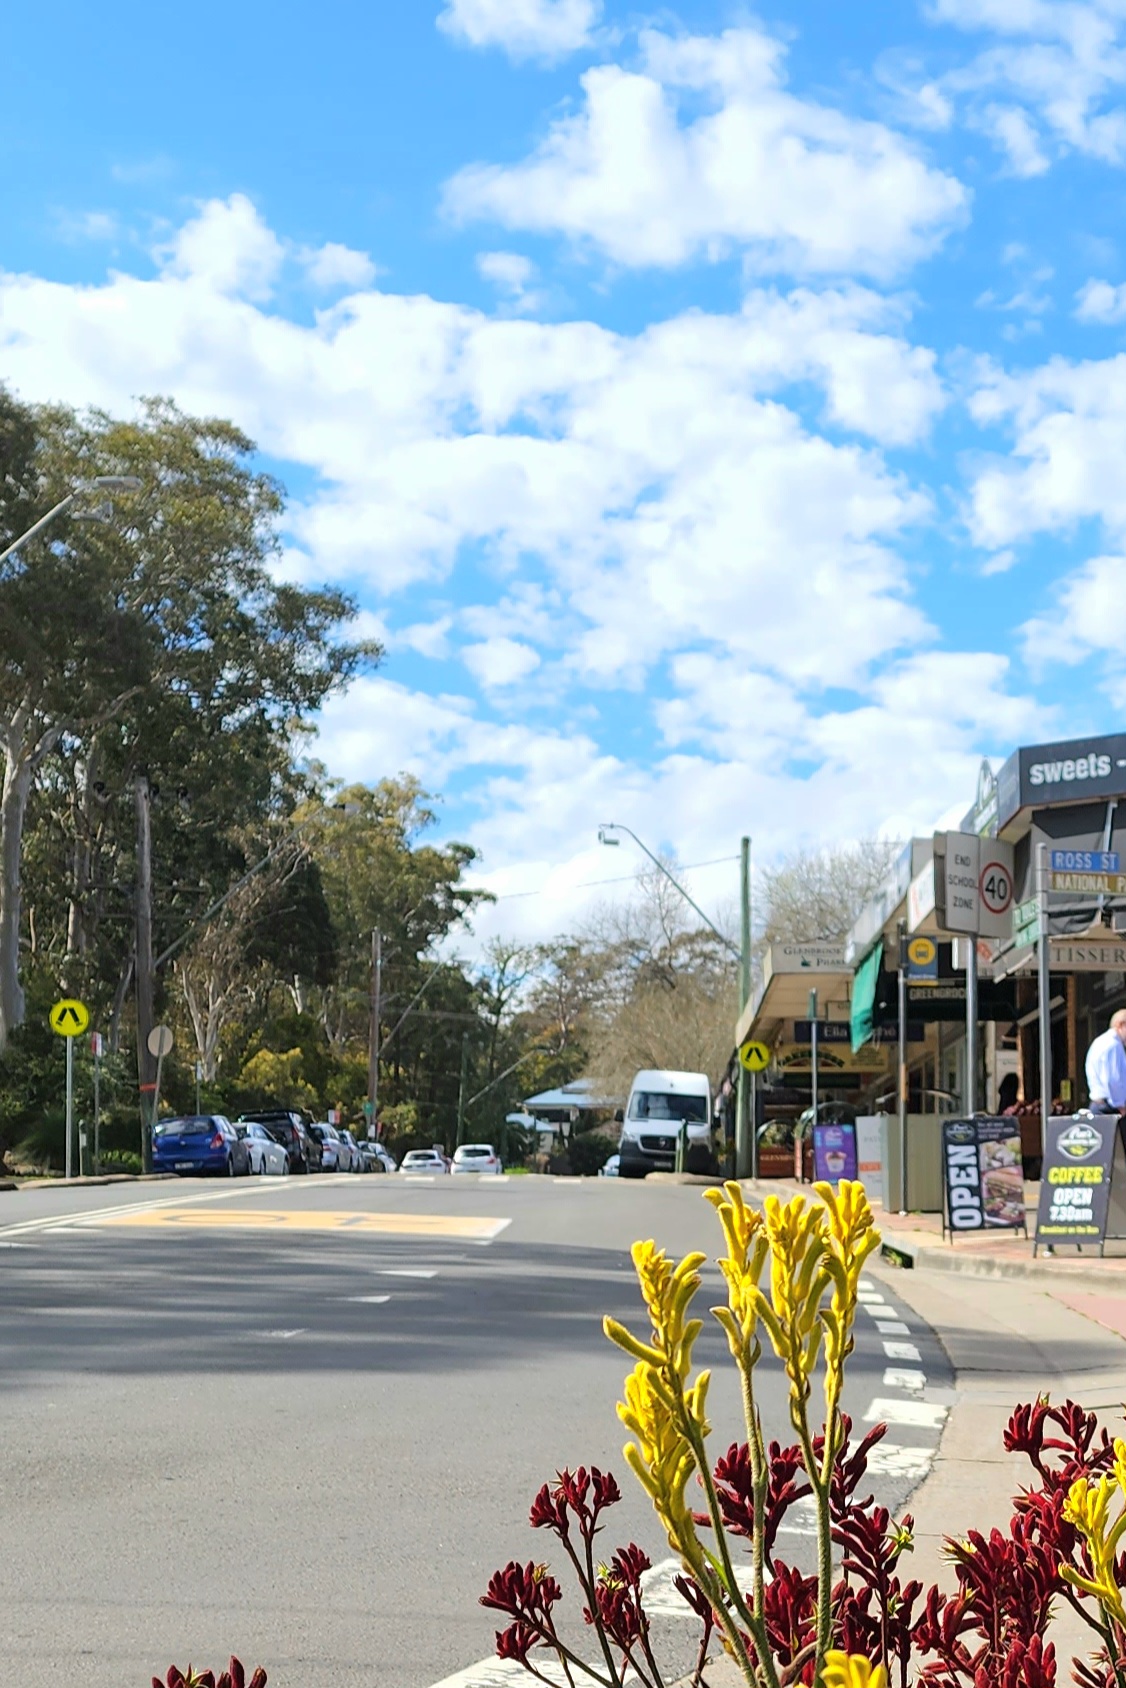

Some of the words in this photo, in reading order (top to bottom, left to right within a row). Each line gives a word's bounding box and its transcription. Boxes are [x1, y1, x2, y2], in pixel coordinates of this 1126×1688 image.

[1029, 752, 1112, 786] sweets
[954, 854, 971, 867] END
[1055, 851, 1093, 869] ROSS
[1101, 852, 1118, 870] ST
[947, 873, 979, 890] SCHOOL
[984, 875, 1008, 901] 40
[1055, 873, 1112, 892] NATIONAL
[952, 895, 974, 911] ZONE
[909, 987, 966, 1001] GREENGROC
[1048, 1166, 1104, 1184] COFFEE
[947, 1144, 983, 1228] OPEN
[1053, 1187, 1094, 1206] OPEN
[1049, 1206, 1094, 1222] 7.30am
